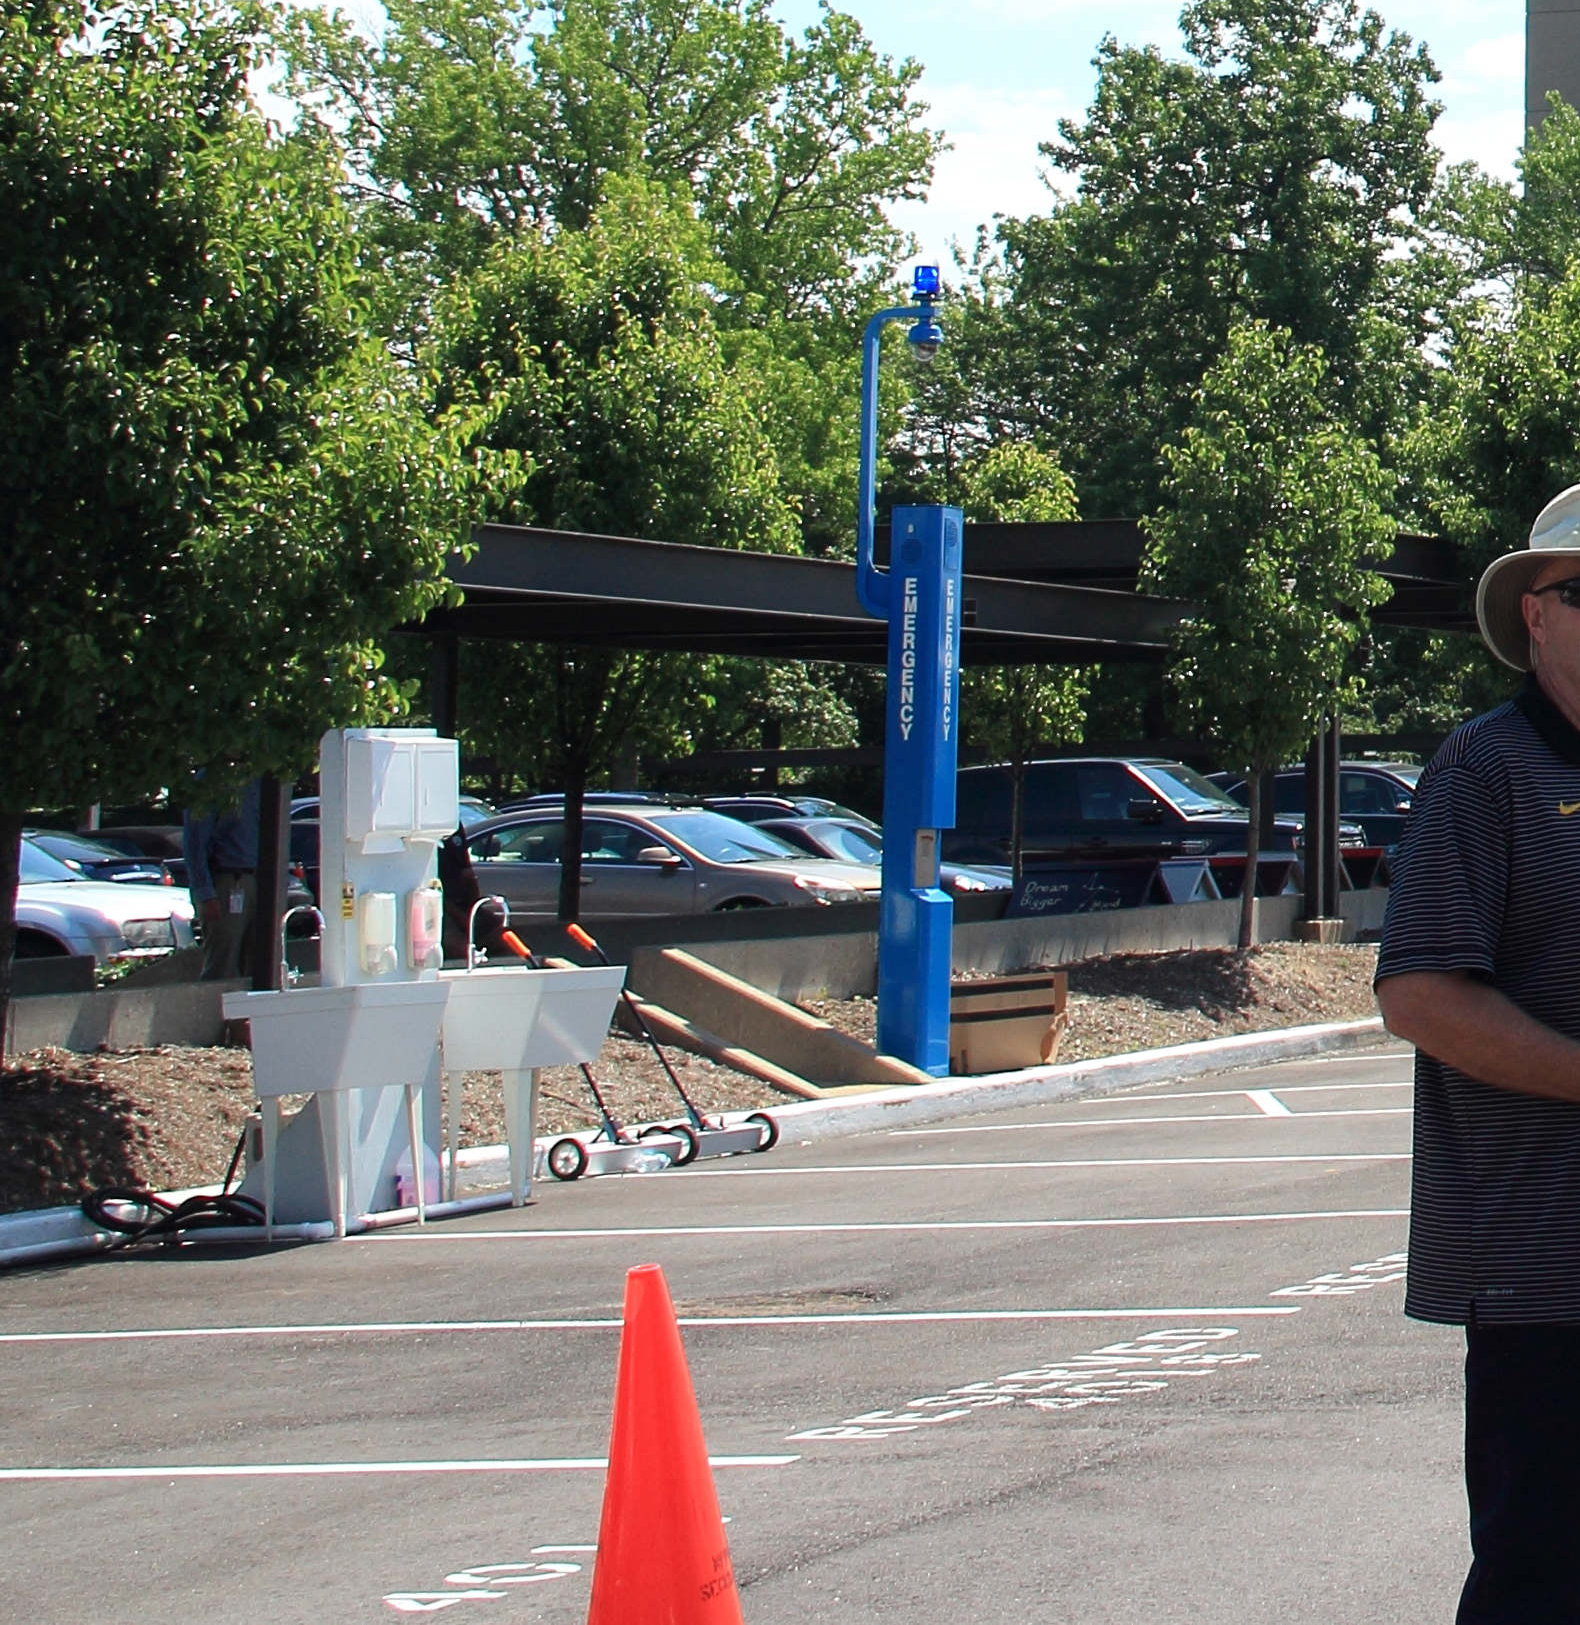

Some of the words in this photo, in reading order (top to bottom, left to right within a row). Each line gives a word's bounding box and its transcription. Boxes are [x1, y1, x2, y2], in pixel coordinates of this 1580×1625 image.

[900, 577, 918, 741] EMERGENCY
[943, 578, 955, 742] EMERGENCY
[1020, 894, 1061, 910] Bigger
[1025, 881, 1069, 894] Dream
[785, 1327, 1240, 1439] RESERVED
[382, 1543, 599, 1612] 401
